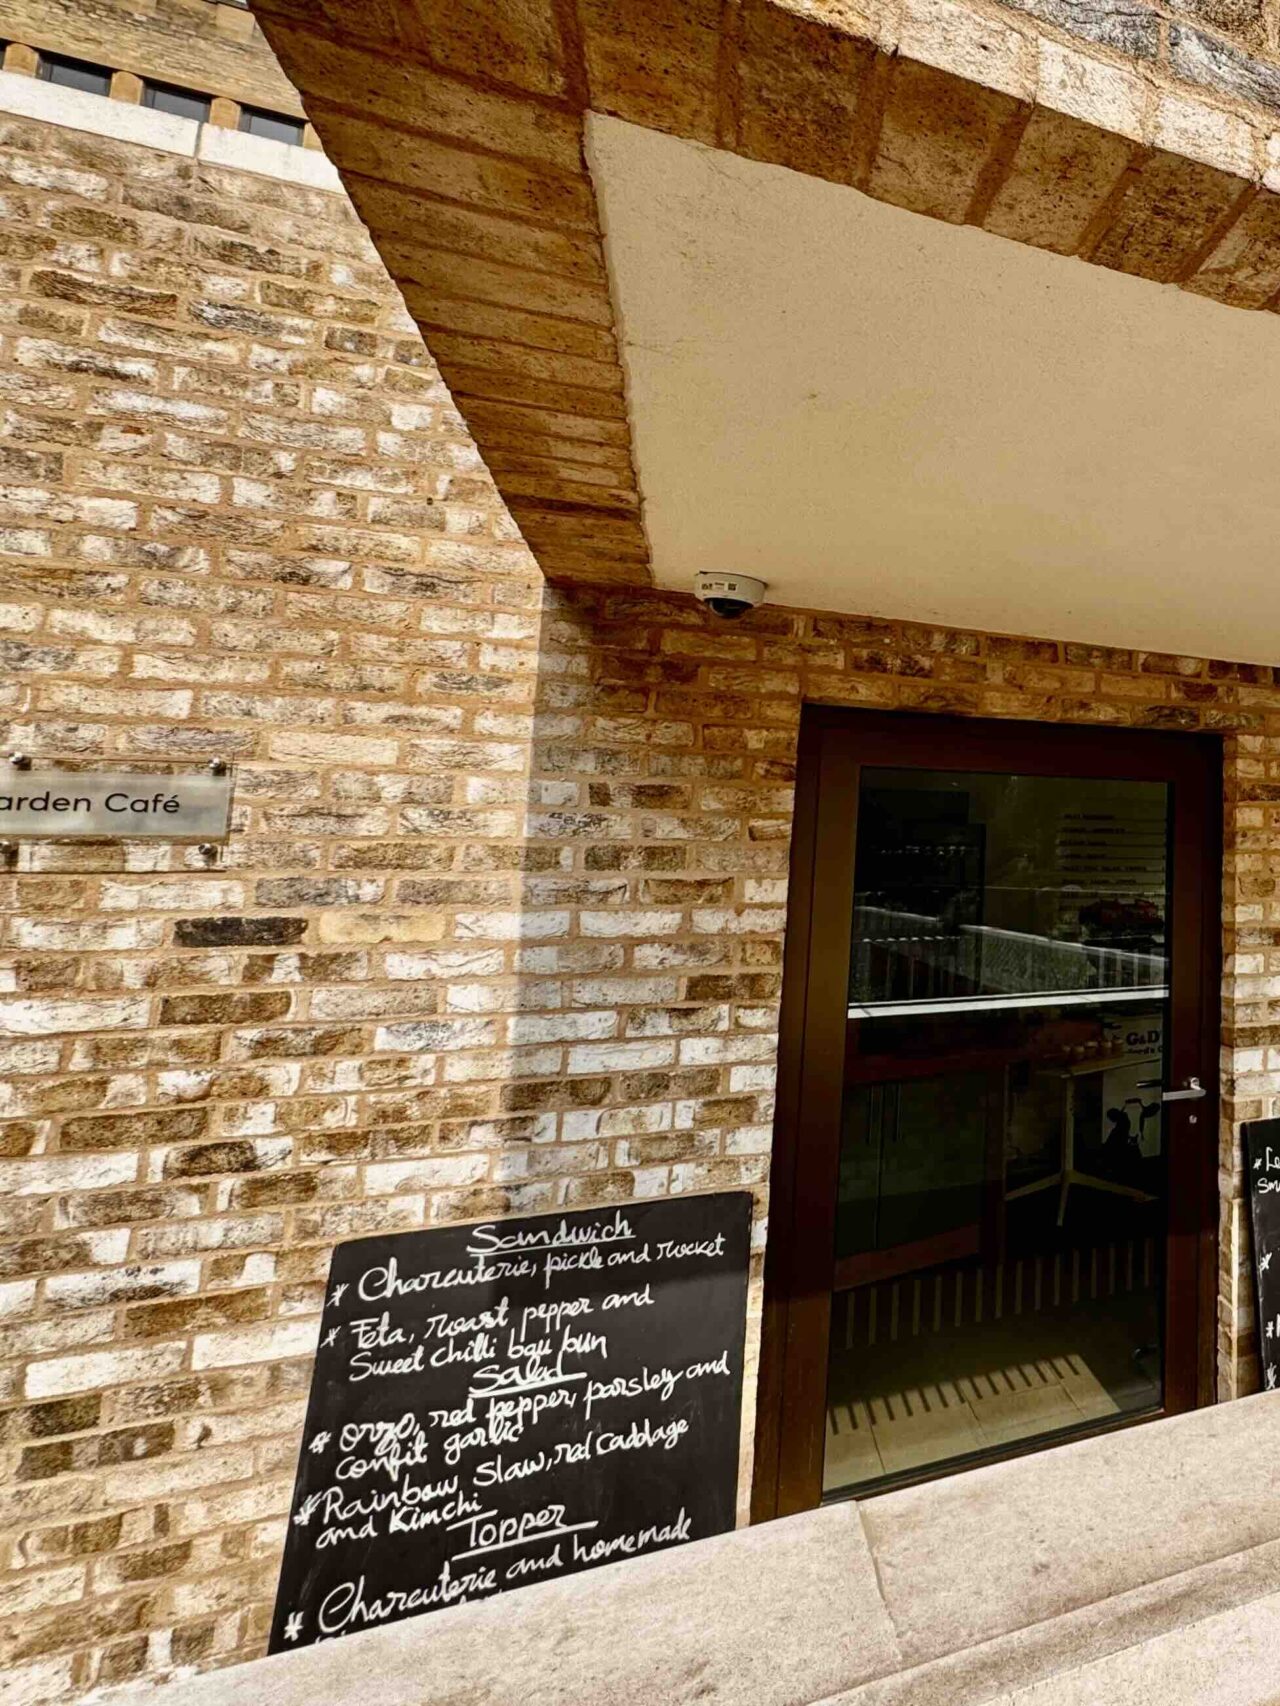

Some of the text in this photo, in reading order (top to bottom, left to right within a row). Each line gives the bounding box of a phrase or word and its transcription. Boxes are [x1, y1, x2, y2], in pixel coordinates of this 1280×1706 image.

[104, 792, 181, 813] Café
[466, 1210, 632, 1253] Sandwich
[545, 1249, 603, 1289] pickle
[608, 1243, 650, 1265] and
[656, 1233, 725, 1261] rocket
[350, 1284, 654, 1349] Feta, roast pepper and
[562, 1325, 608, 1358] bun
[429, 1398, 474, 1427] red
[583, 1368, 682, 1421] parsley
[685, 1351, 730, 1378] and
[468, 1353, 566, 1394] Salad
[444, 1420, 523, 1465] garlic
[323, 1474, 458, 1525] Rainbow
[555, 1434, 592, 1464] red
[316, 1521, 377, 1551] and
[447, 1504, 566, 1549] Topper
[319, 1562, 497, 1633] Charcuterie
[506, 1549, 563, 1578] and
